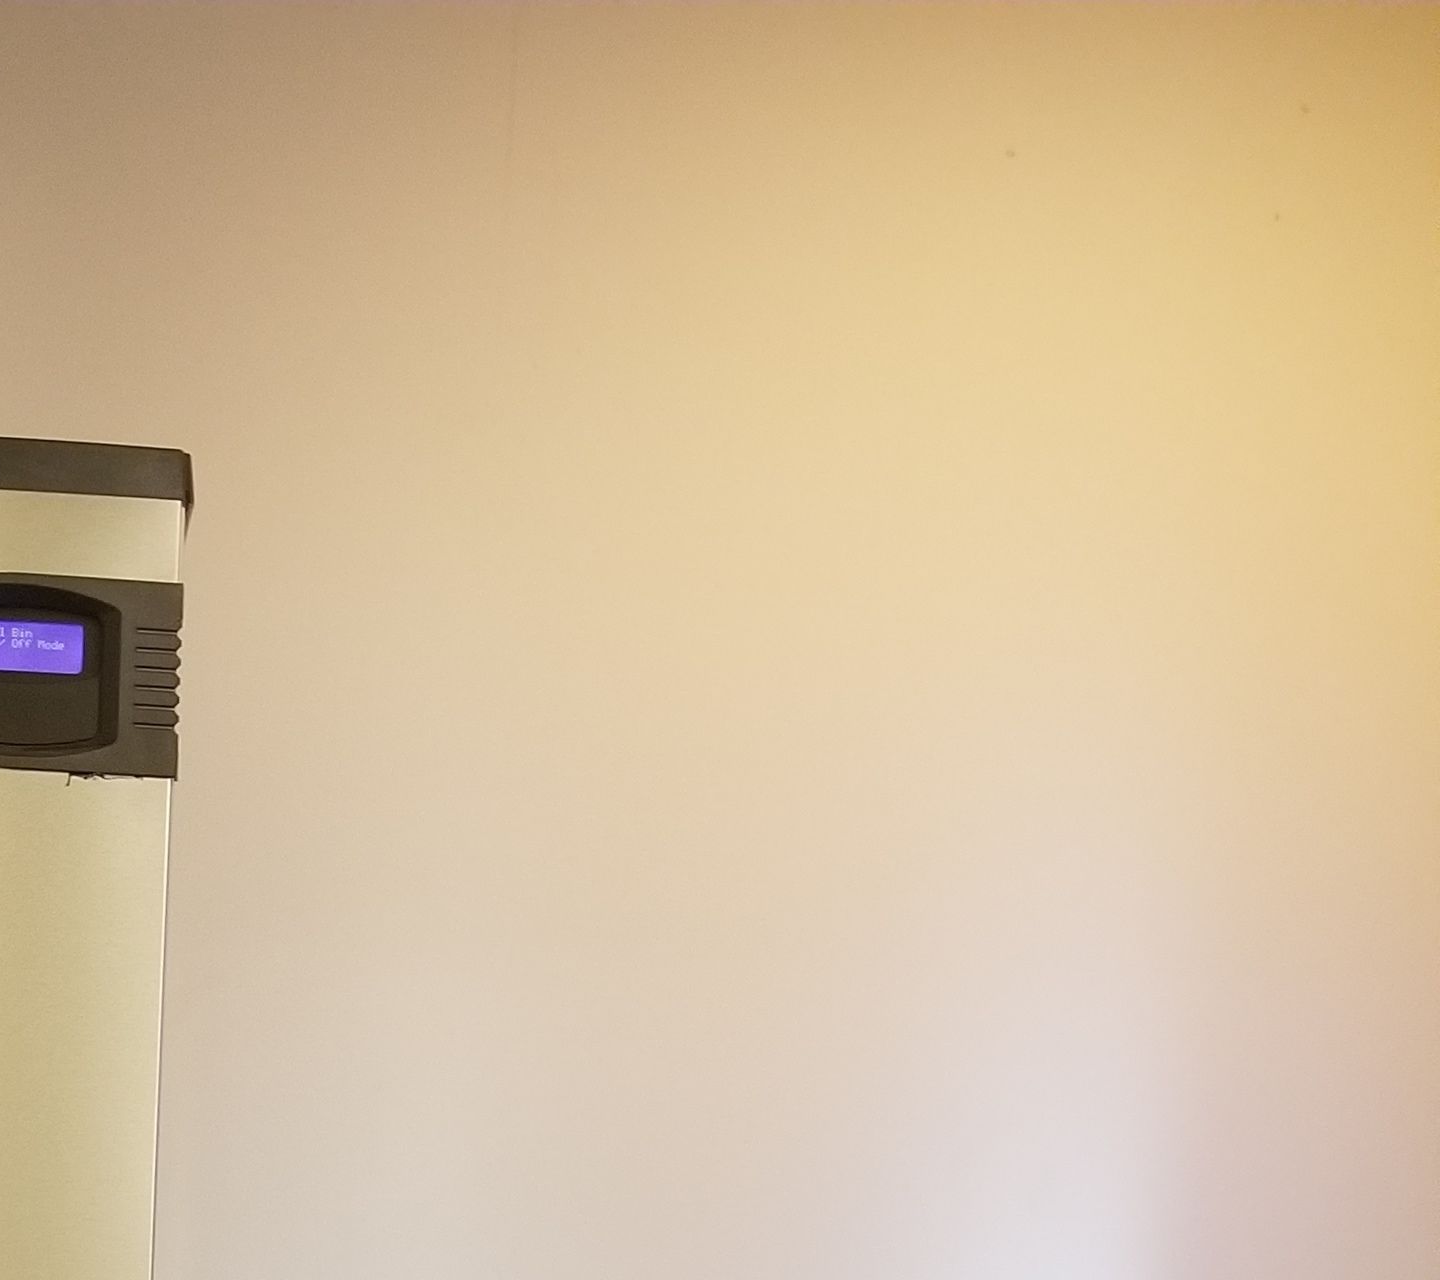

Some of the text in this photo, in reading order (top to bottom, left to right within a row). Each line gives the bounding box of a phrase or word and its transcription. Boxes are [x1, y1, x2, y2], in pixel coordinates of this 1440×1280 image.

[11, 627, 33, 638] Bin
[11, 638, 32, 649] Off
[37, 639, 65, 651] Mode
